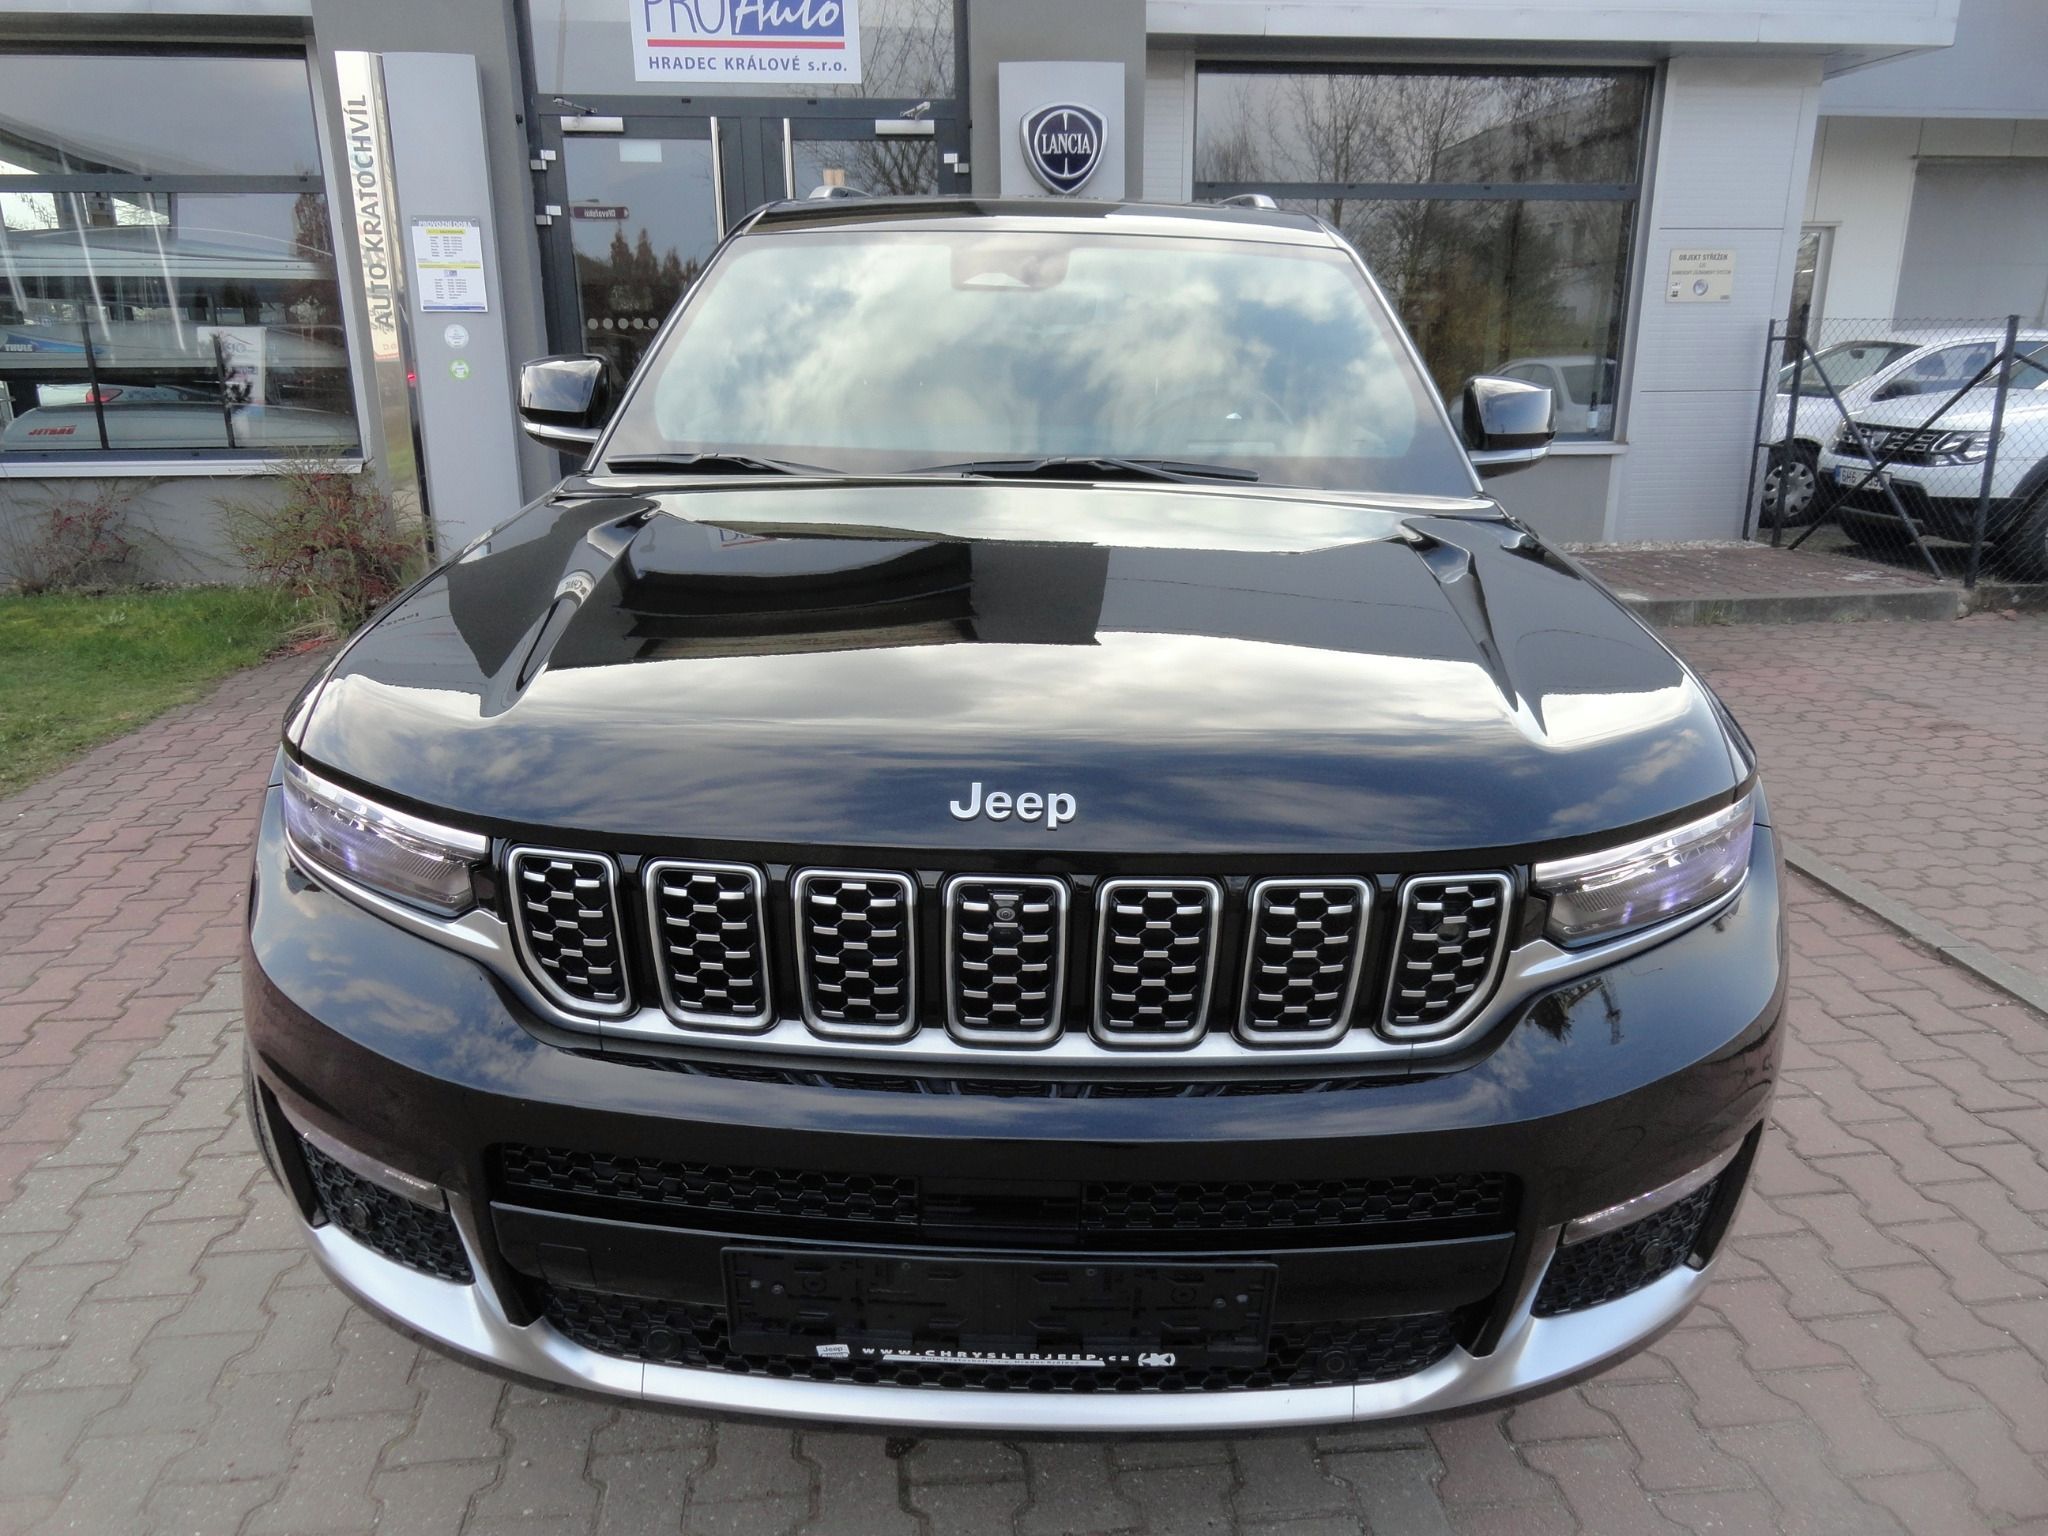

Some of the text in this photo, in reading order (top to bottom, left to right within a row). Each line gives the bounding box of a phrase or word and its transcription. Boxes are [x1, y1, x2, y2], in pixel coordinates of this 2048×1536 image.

[649, 55, 848, 72] HRADEC KRÁLOVÉ s.r.o.
[1041, 133, 1092, 155] LANCIA
[343, 94, 385, 252] KRATOCHVÍL
[367, 262, 394, 329] AUTO
[950, 782, 1077, 831] Jeep
